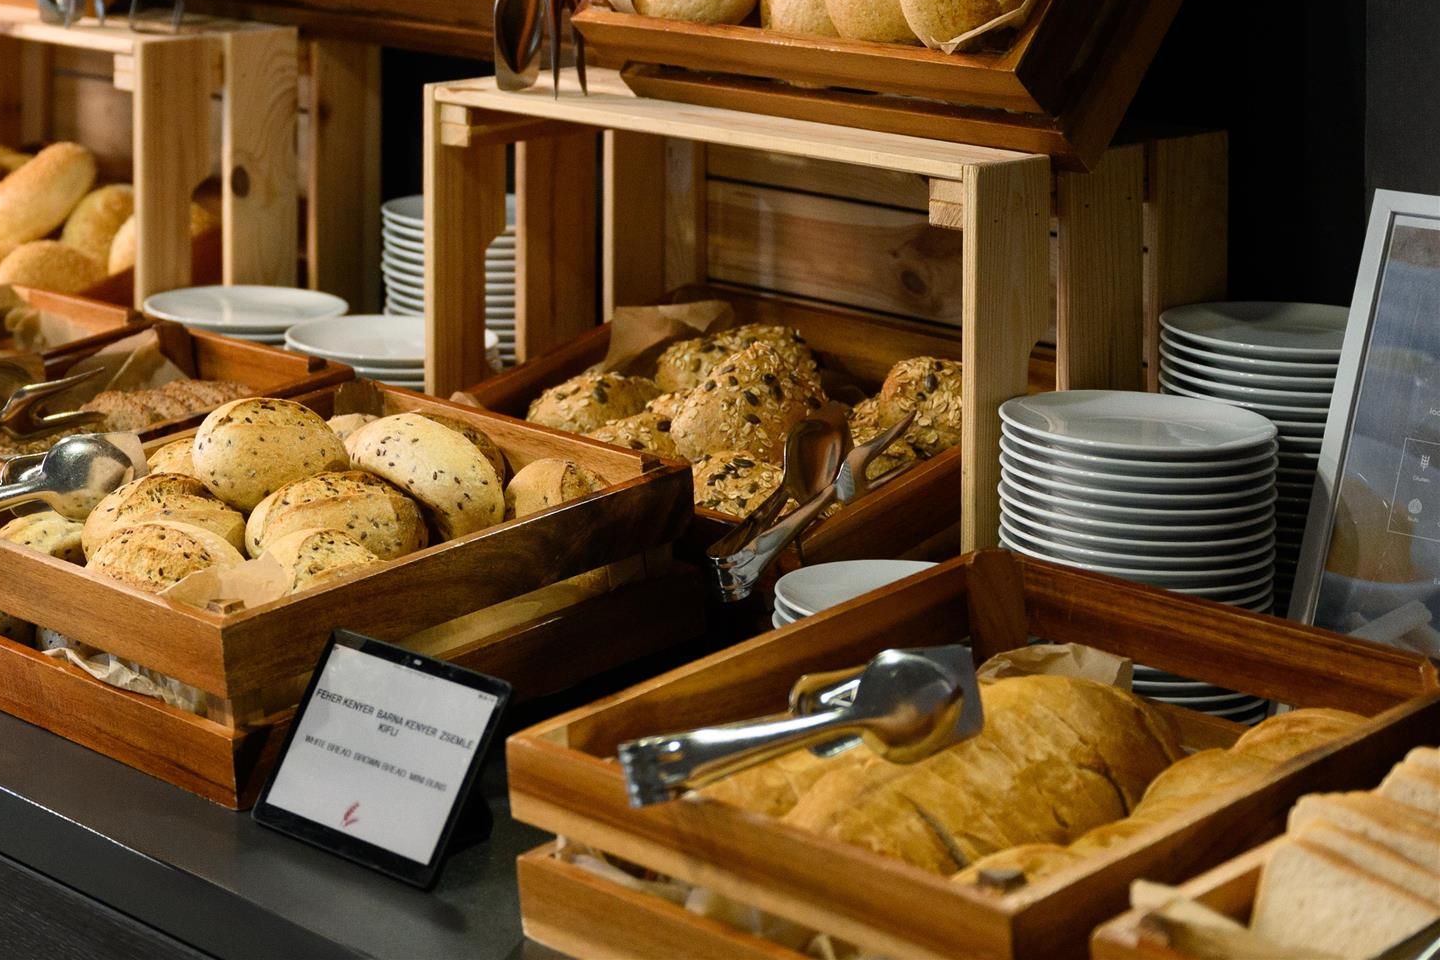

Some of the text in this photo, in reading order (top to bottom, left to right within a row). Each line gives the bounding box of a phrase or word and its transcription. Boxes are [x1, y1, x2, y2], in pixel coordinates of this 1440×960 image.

[376, 709, 404, 726] BARNA
[304, 735, 326, 750] WHITE
[326, 743, 352, 758] BREAD
[353, 751, 381, 769] BROWN
[381, 761, 408, 778] BREAD
[409, 772, 426, 785] MINI
